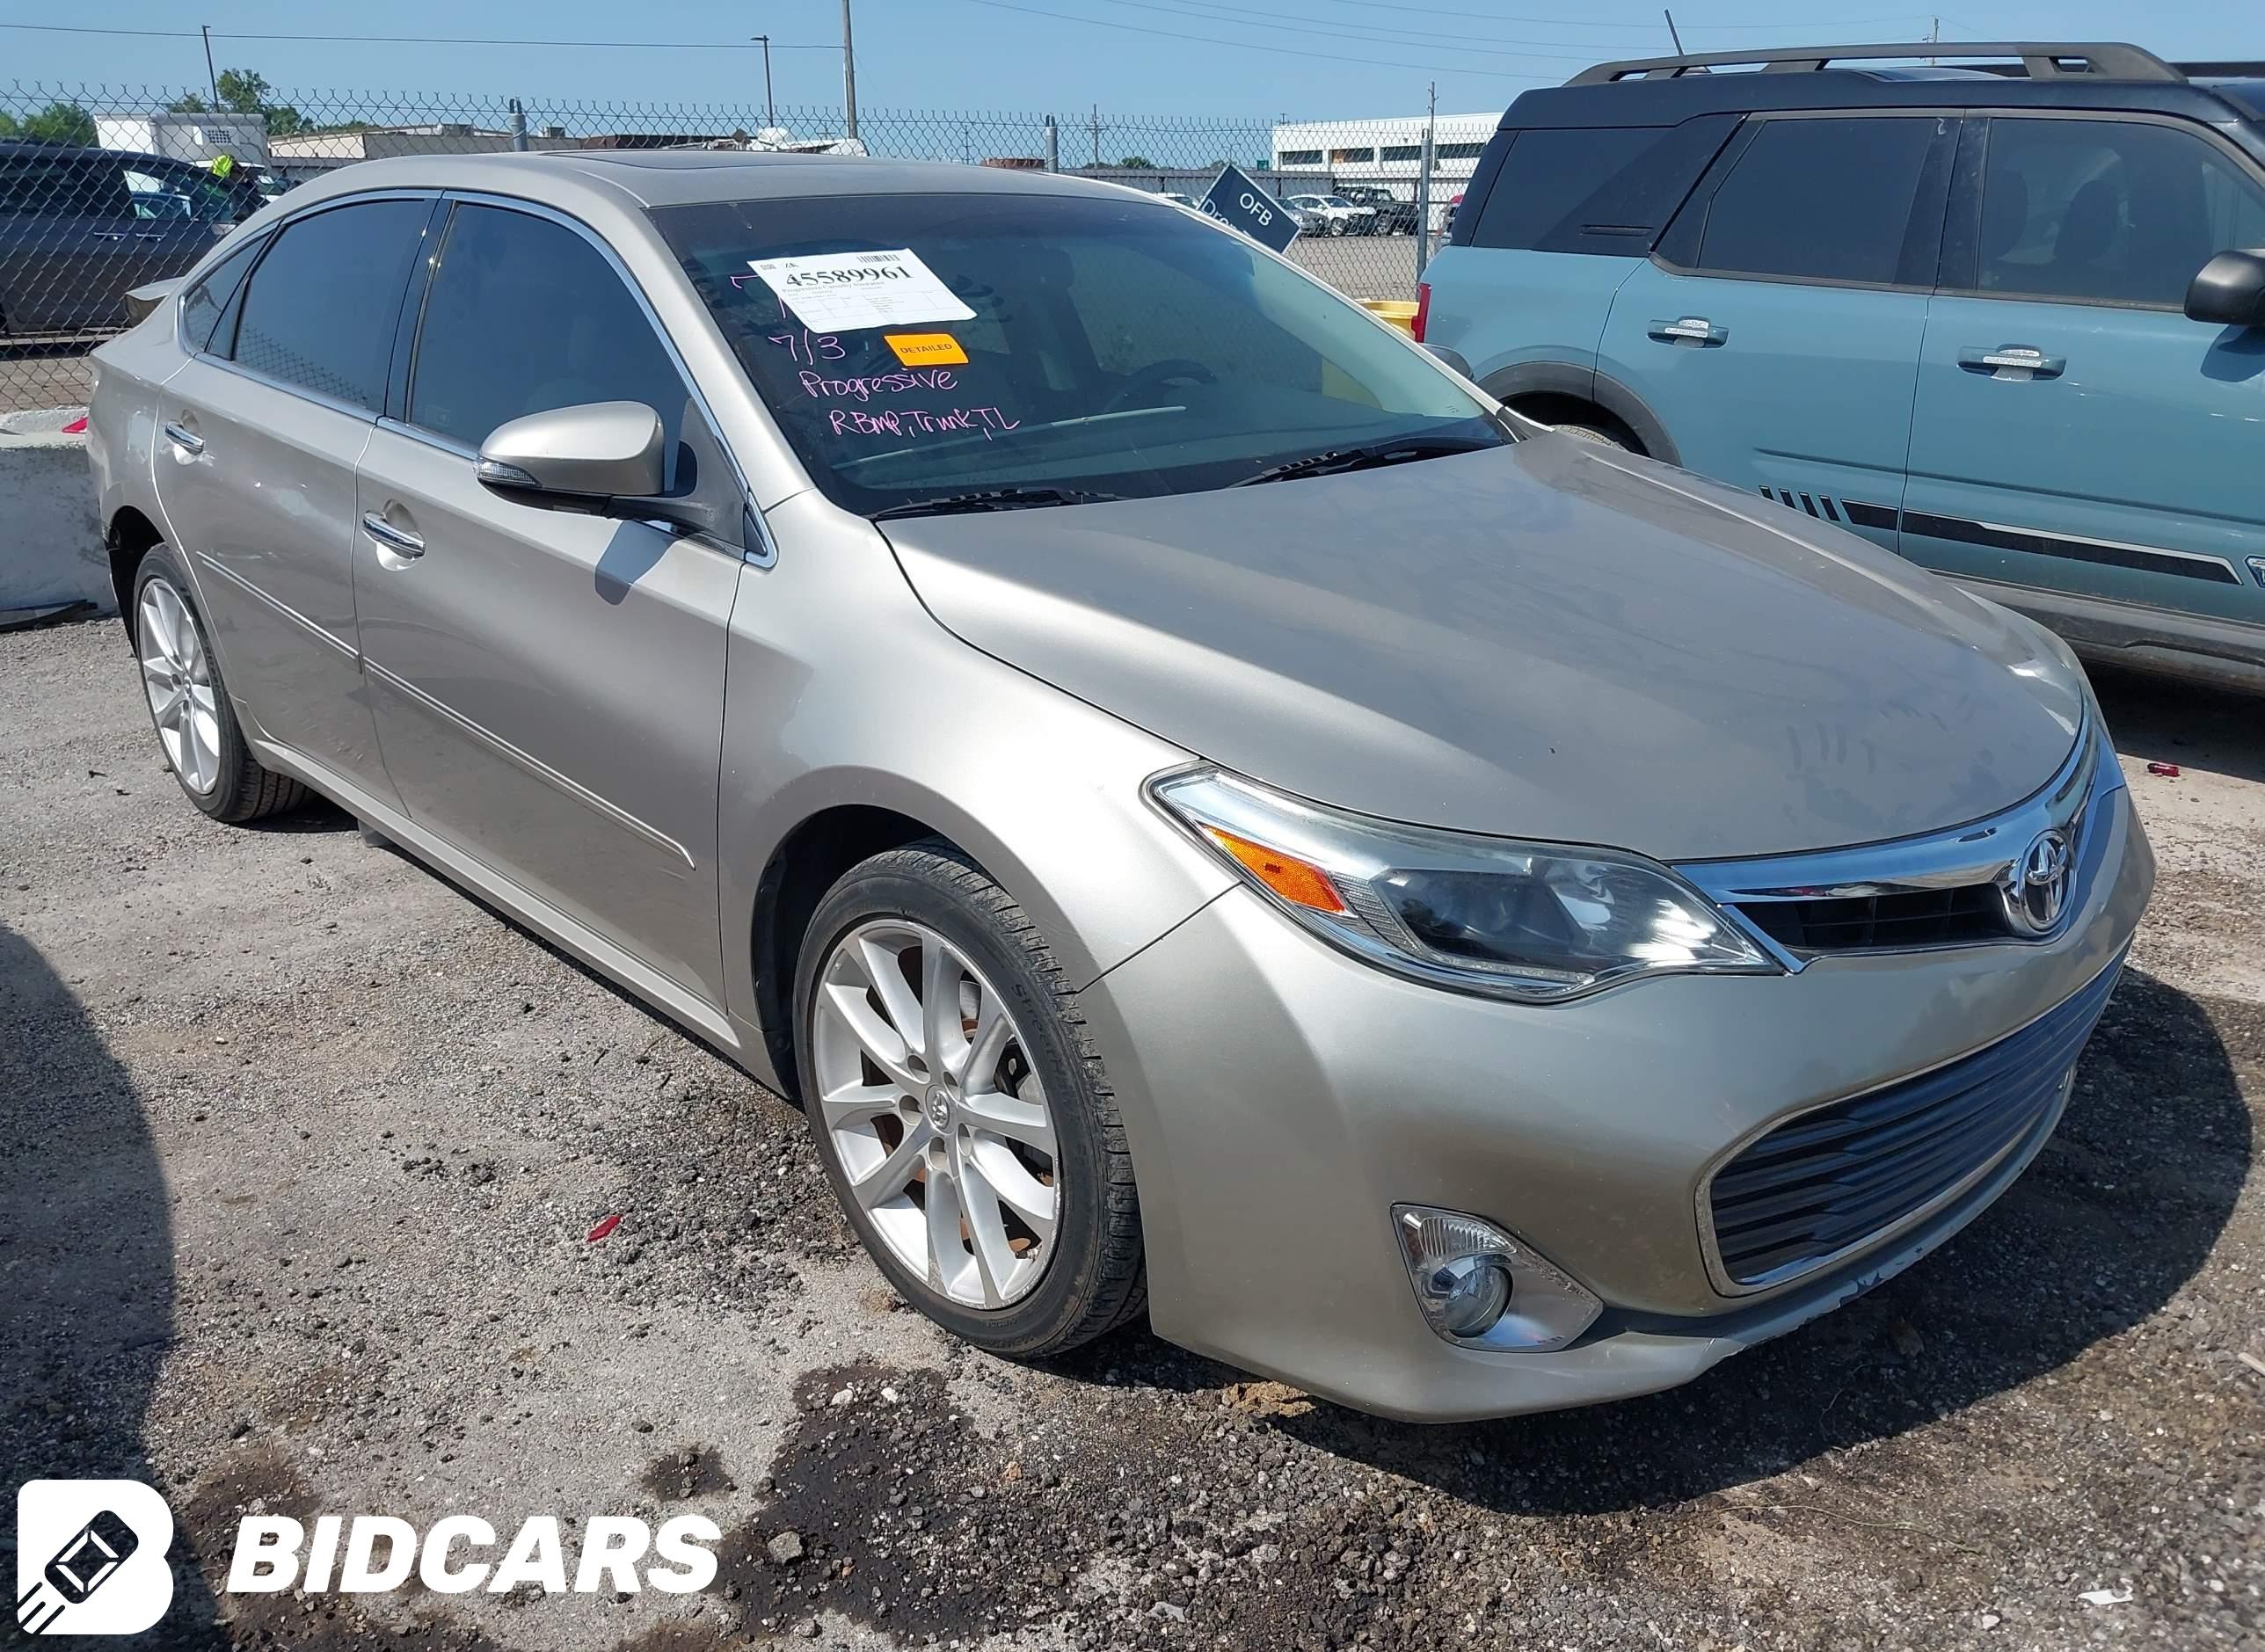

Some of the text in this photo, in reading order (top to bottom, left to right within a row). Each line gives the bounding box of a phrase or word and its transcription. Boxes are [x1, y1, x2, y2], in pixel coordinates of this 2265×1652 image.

[1239, 193, 1273, 226] OFB
[785, 266, 914, 287] 45589961
[768, 329, 846, 366] 7/3
[899, 343, 953, 353] DETAILED
[798, 367, 958, 402] Progressive
